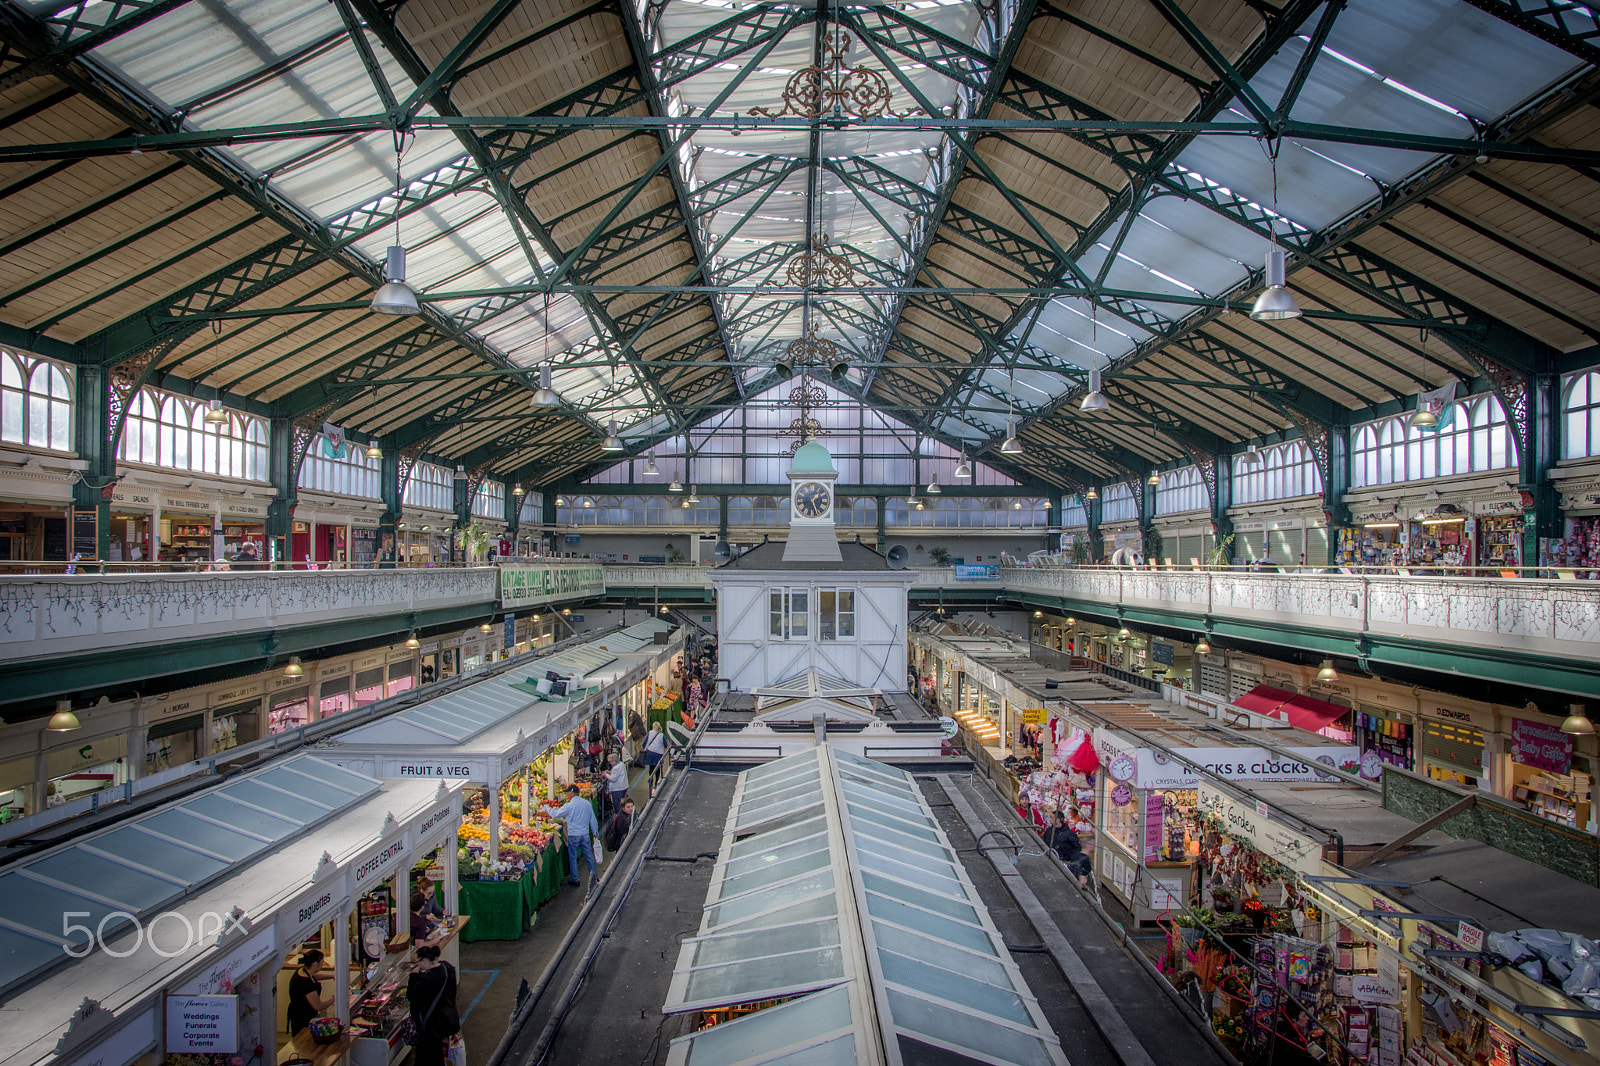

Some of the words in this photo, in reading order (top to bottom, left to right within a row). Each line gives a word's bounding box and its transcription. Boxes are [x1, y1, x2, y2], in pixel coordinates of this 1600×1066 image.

[1520, 738, 1540, 758] Baby
[1542, 744, 1566, 764] Gifts
[400, 766, 433, 775] FRUIT
[436, 766, 444, 776] &
[446, 766, 470, 776] VEG
[1236, 764, 1246, 775] &
[1251, 760, 1309, 775] CLOCKS
[420, 818, 433, 834] Jacket
[433, 806, 450, 825] Potatoes
[1227, 806, 1256, 838] Garden
[356, 857, 380, 882] COFFEE
[380, 839, 404, 866] CENTRAL
[298, 892, 331, 924] Baguettes
[1460, 924, 1482, 940] FRAGILE
[1462, 933, 1477, 946] ROOF
[183, 1013, 220, 1022] Weddings
